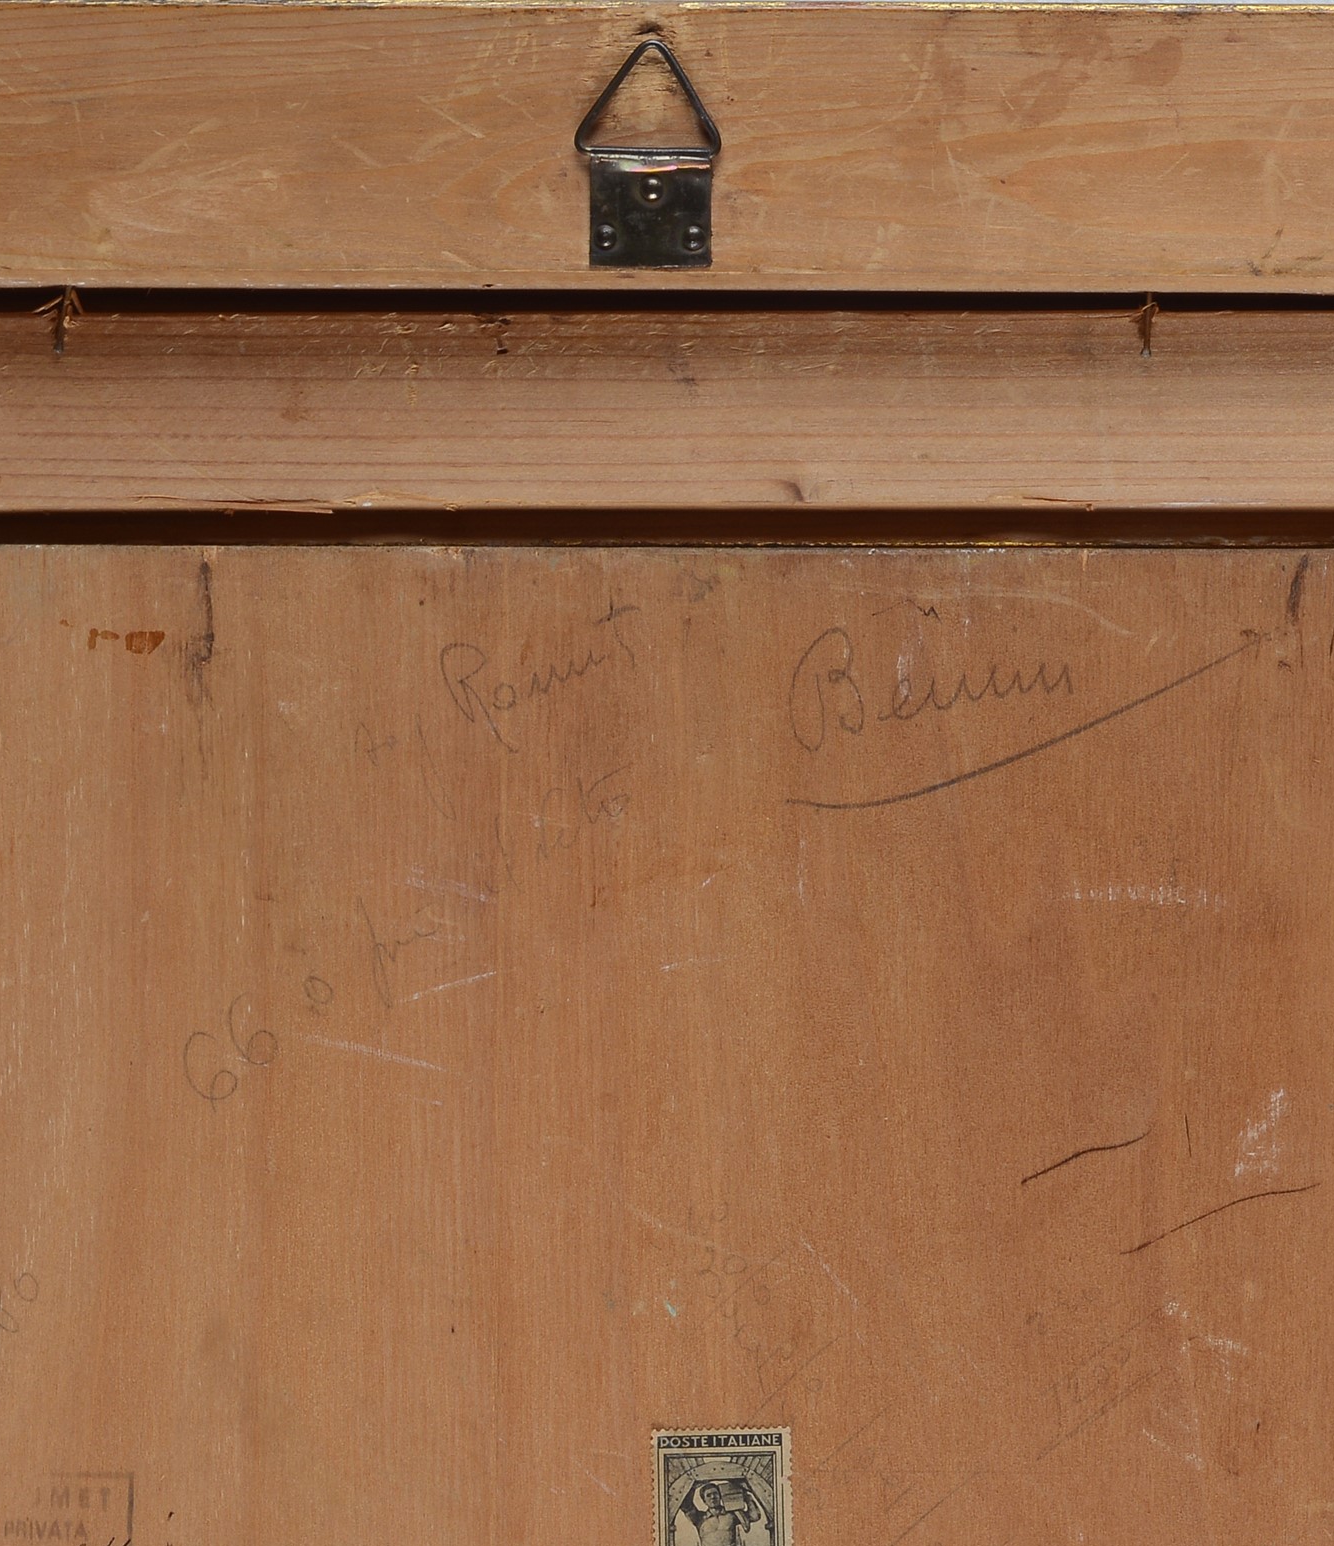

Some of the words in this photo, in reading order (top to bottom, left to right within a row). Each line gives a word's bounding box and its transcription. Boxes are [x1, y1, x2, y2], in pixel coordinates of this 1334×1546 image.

[660, 1436, 708, 1448] POSTE
[712, 1434, 781, 1447] ITALIANE
[4, 1518, 89, 1542] PRIVATA
